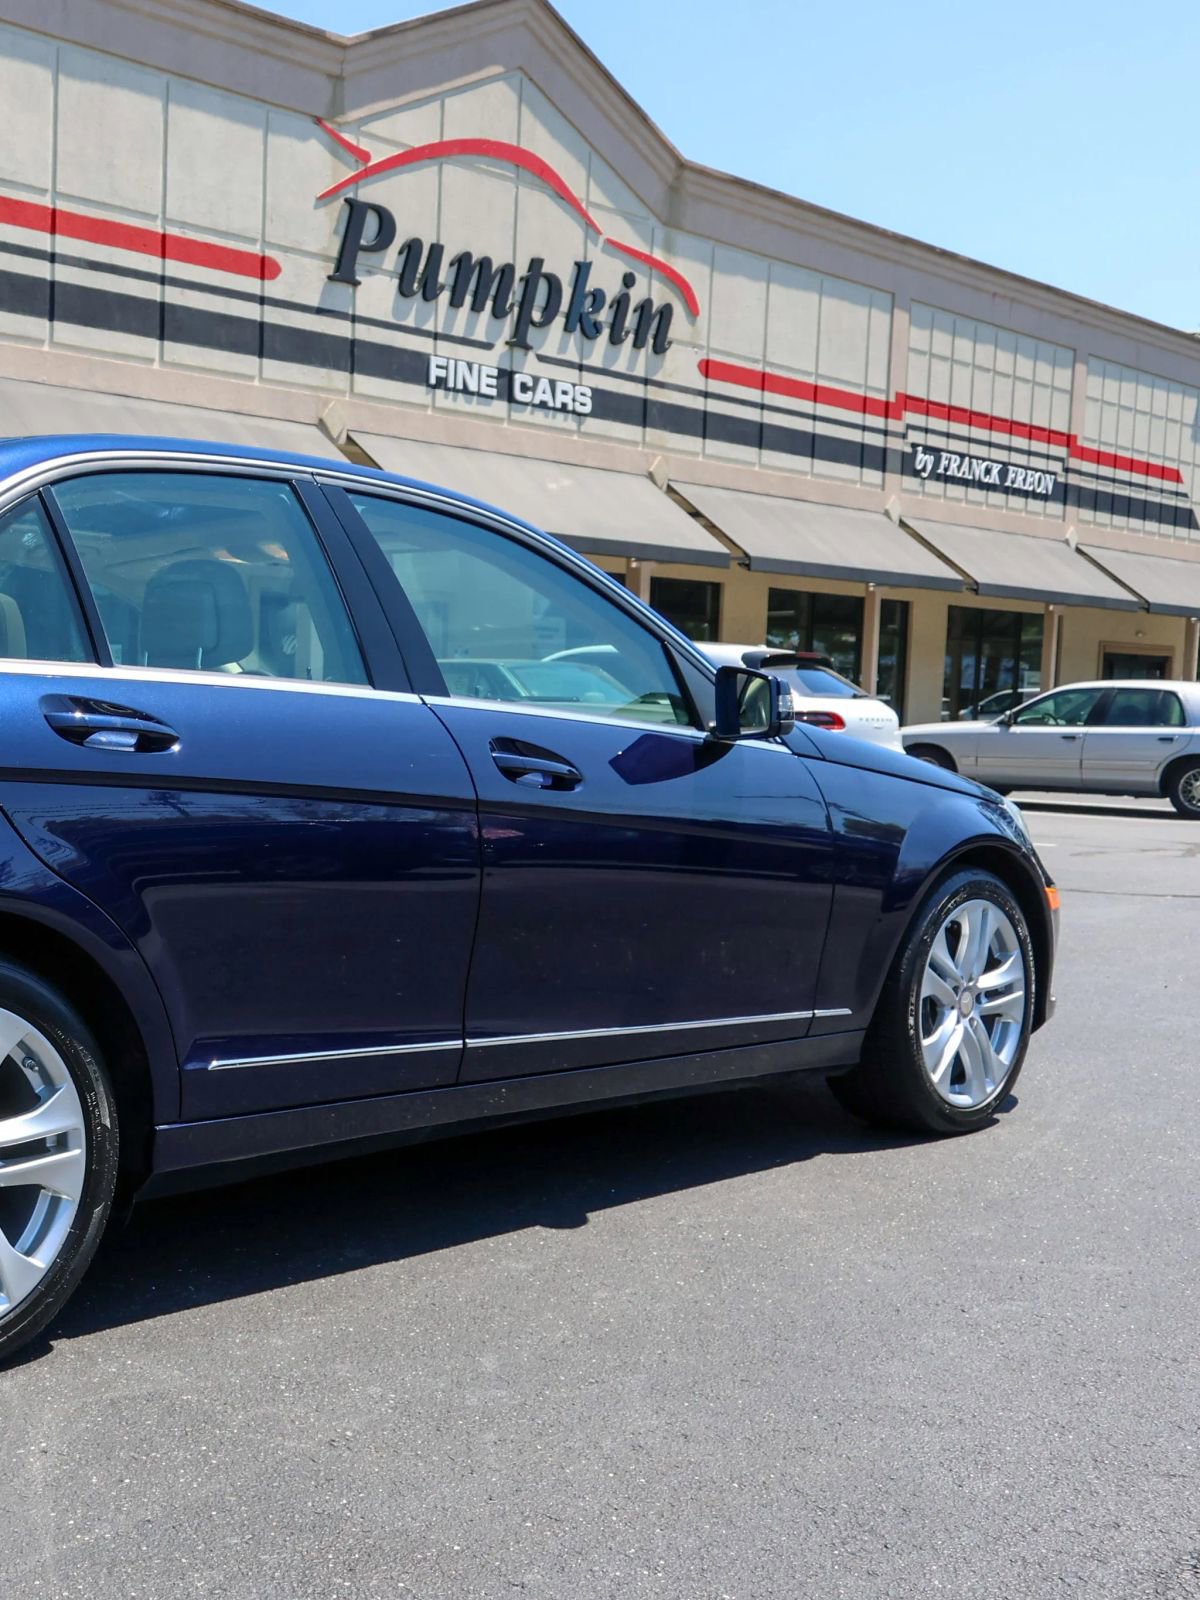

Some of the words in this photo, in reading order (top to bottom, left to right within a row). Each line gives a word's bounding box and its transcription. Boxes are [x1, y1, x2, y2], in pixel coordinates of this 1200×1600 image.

[327, 197, 674, 354] Pumpkin
[429, 355, 499, 398] FINE
[513, 372, 593, 415] CARS
[914, 446, 935, 478] by
[937, 452, 1002, 485] FRANCK
[1004, 465, 1056, 495] FREON
